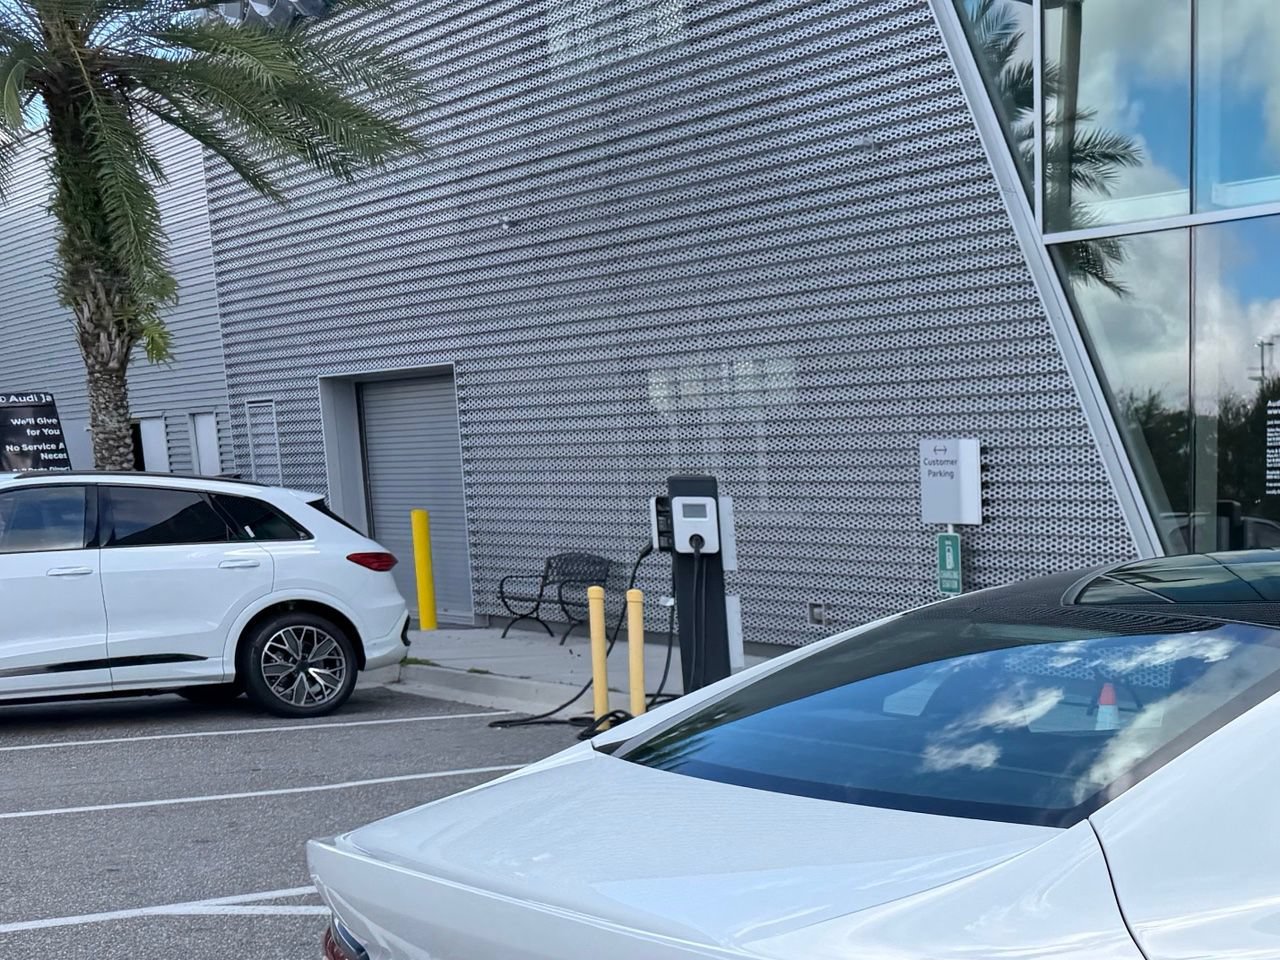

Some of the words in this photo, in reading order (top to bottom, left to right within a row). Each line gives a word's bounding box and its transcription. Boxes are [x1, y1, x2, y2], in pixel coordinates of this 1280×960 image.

[9, 394, 39, 403] Audi
[26, 428, 41, 436] for
[5, 444, 20, 452] No
[21, 443, 56, 451] Service
[923, 457, 958, 467] Customer
[927, 468, 954, 480] Parking
